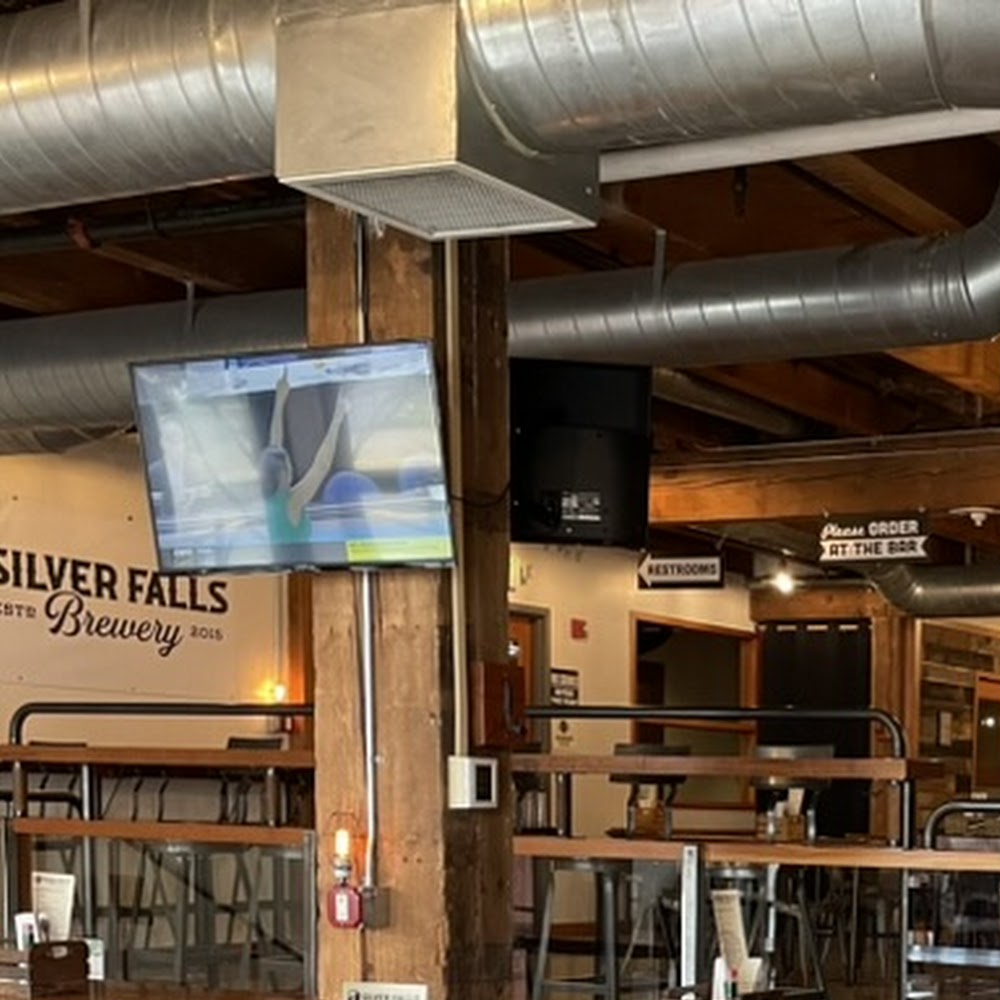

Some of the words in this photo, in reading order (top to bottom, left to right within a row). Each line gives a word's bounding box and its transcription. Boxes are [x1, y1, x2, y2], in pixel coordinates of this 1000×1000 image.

[821, 522, 865, 540] Please
[868, 520, 918, 536] ORDER
[830, 544, 848, 556] AT
[855, 542, 883, 555] THE
[888, 540, 917, 554] BAR
[648, 563, 716, 576] RESTROOMS
[128, 567, 228, 613] FALLS
[45, 591, 182, 657] Brewery
